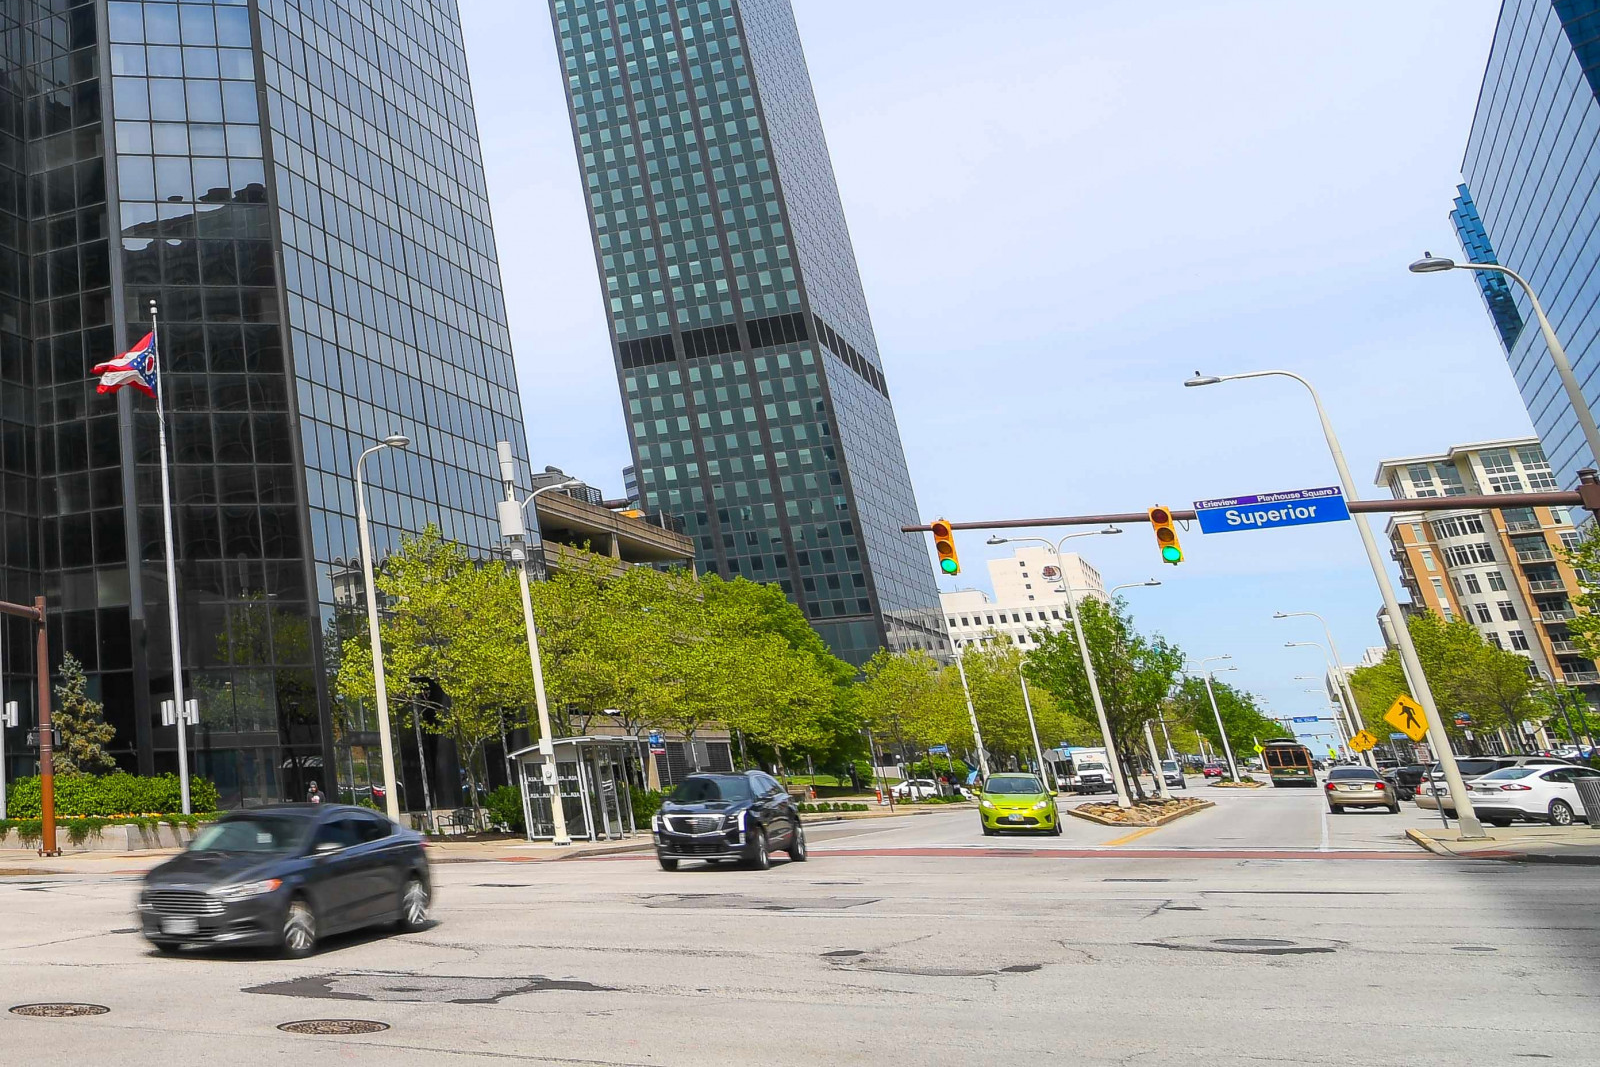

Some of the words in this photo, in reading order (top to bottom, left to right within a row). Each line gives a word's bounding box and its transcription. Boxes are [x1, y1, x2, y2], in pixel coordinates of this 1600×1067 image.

[1202, 499, 1238, 508] Erieview
[1257, 491, 1301, 503] Playhouse
[1302, 489, 1333, 499] Square
[1225, 504, 1317, 527] Superior
